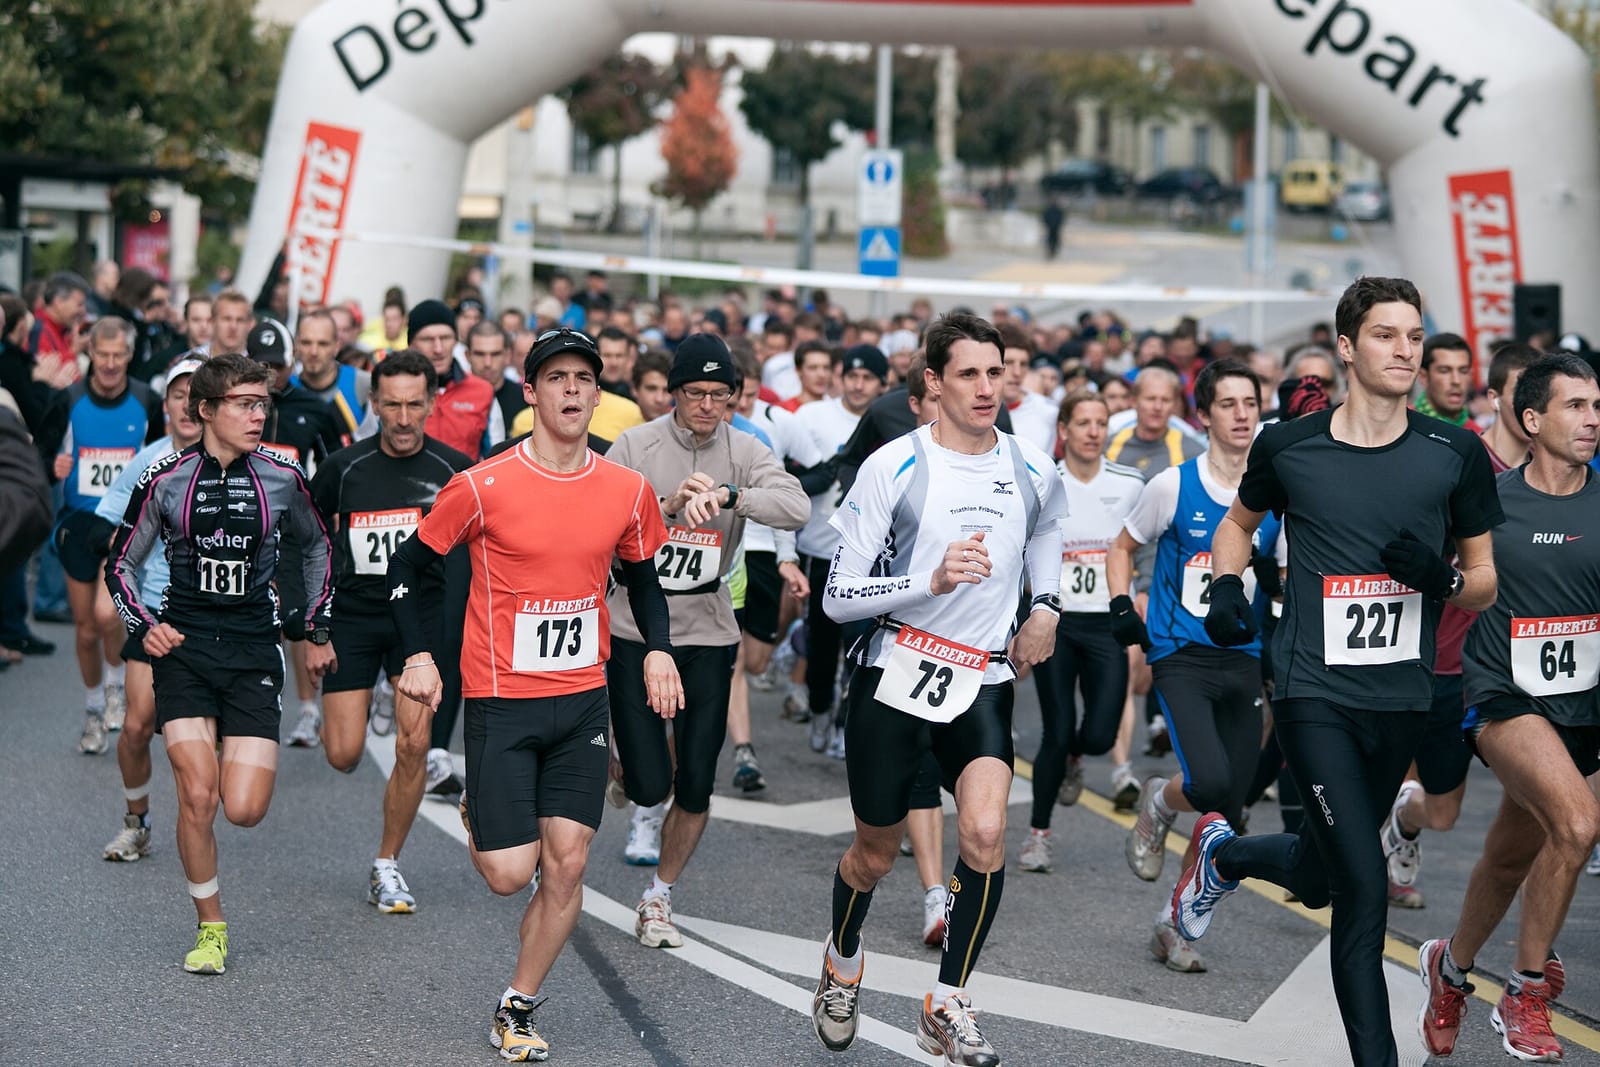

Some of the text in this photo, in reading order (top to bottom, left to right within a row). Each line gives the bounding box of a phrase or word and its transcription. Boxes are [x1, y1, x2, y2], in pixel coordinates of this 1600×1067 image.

[354, 516, 368, 528] LA
[950, 506, 1004, 518] Triathlon Fribourg
[1532, 533, 1564, 544] RUN
[202, 561, 243, 594] 181
[658, 545, 703, 581] 274
[1072, 566, 1096, 594] 30
[1330, 579, 1417, 596] LA LIBER
[522, 594, 597, 613] LA LIBERTÉ
[537, 617, 582, 658] 173
[1346, 602, 1404, 649] 227
[1517, 617, 1598, 637] LA LIBERTÉ
[902, 633, 985, 668] LA LIBERTÉ
[1540, 640, 1576, 681] 64
[909, 660, 953, 708] 73
